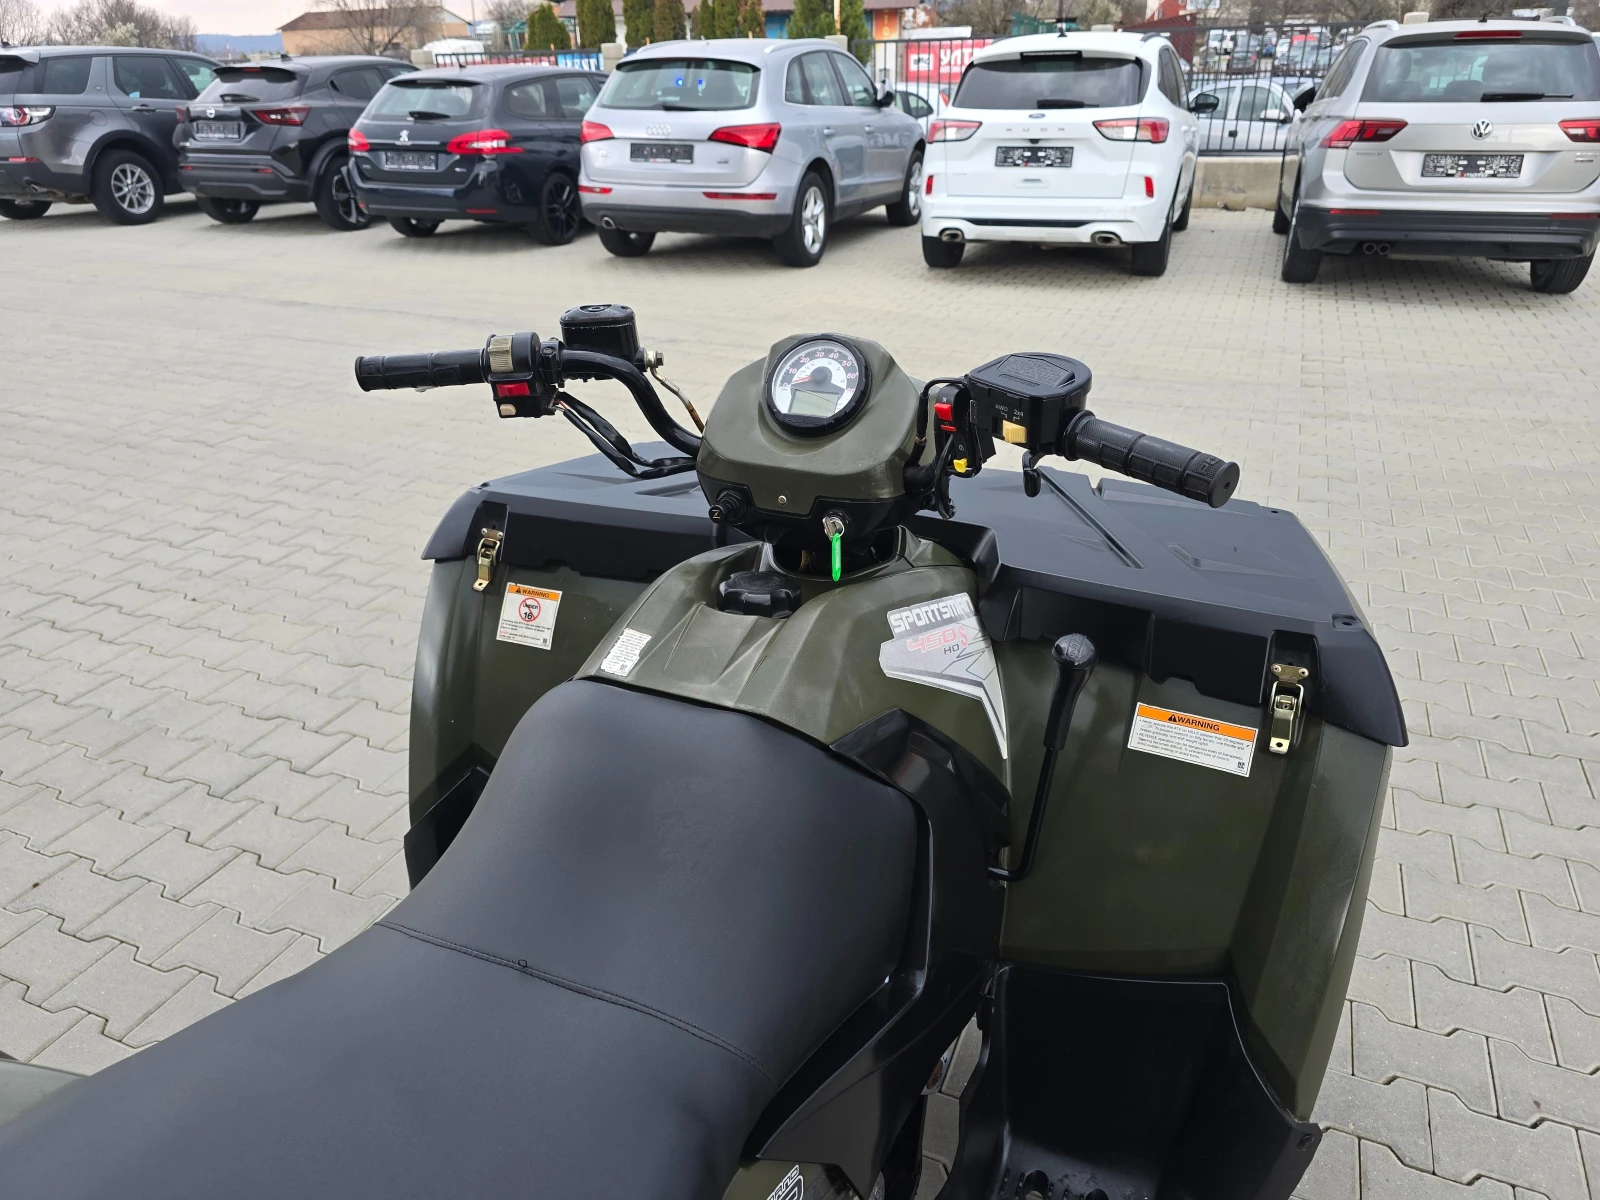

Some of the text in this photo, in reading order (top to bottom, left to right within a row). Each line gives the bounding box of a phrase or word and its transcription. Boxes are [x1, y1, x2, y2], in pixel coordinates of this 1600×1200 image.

[995, 404, 1008, 412] AWD
[1013, 410, 1024, 418] 2x4
[522, 589, 550, 598] WARNING
[524, 612, 533, 620] 16
[889, 596, 975, 633] SPORTSMAN
[906, 626, 958, 653] 450
[1178, 716, 1220, 731] WARNING
